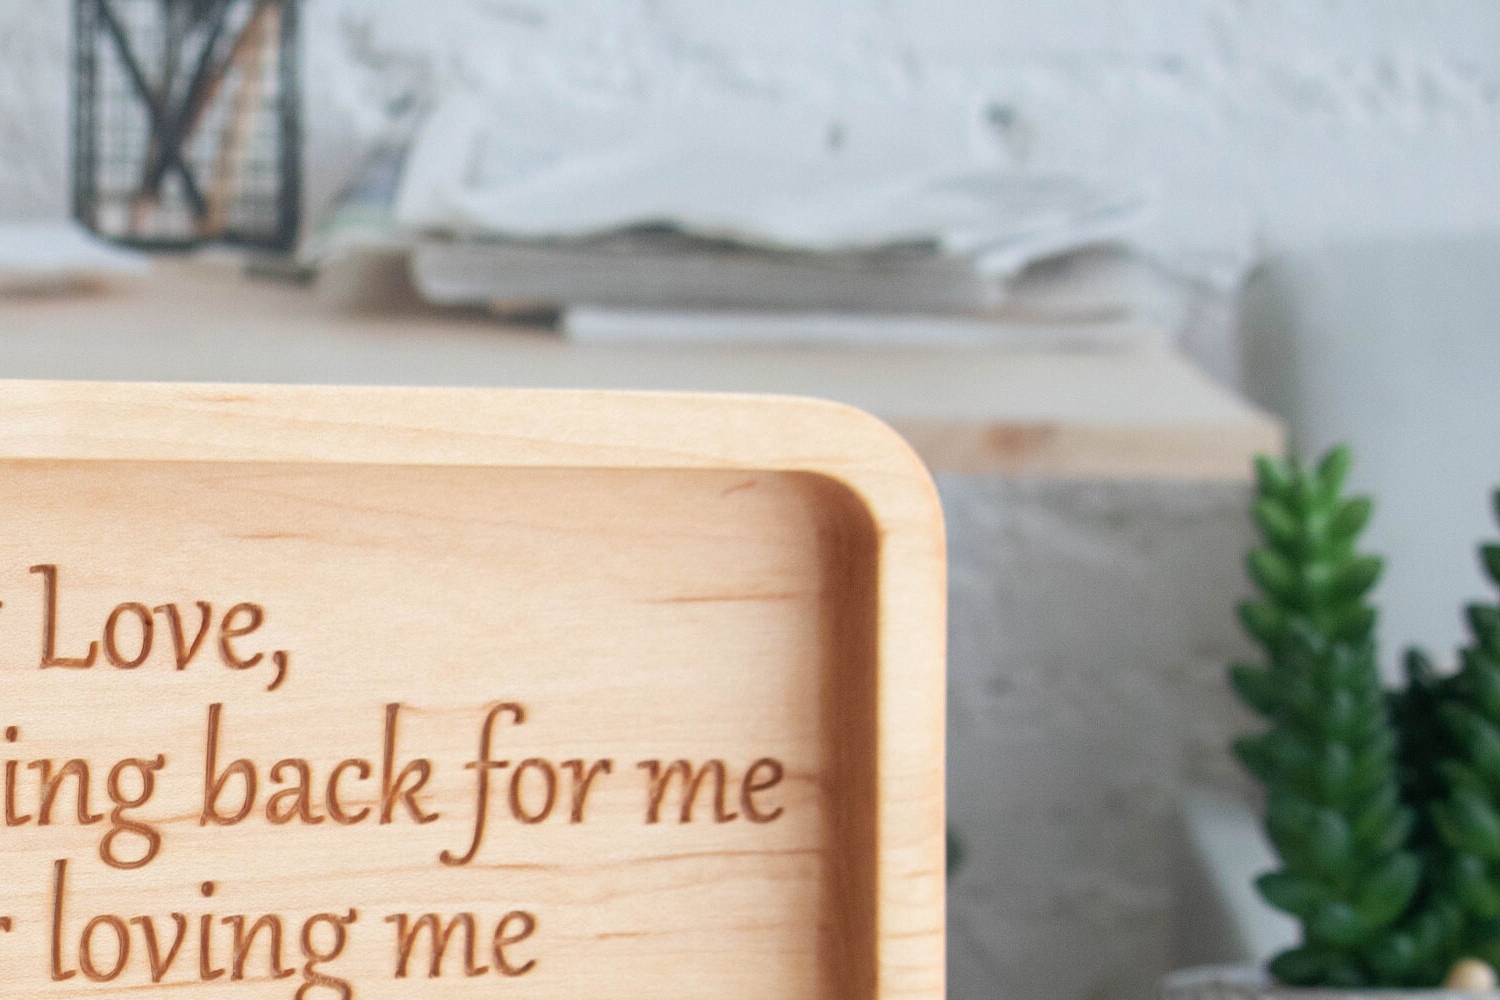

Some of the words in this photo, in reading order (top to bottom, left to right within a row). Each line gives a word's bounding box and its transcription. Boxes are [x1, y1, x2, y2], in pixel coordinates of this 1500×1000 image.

[29, 564, 290, 690] Love,
[199, 702, 440, 827] back
[438, 702, 612, 866] for
[636, 756, 785, 826] me
[386, 908, 539, 979] me
